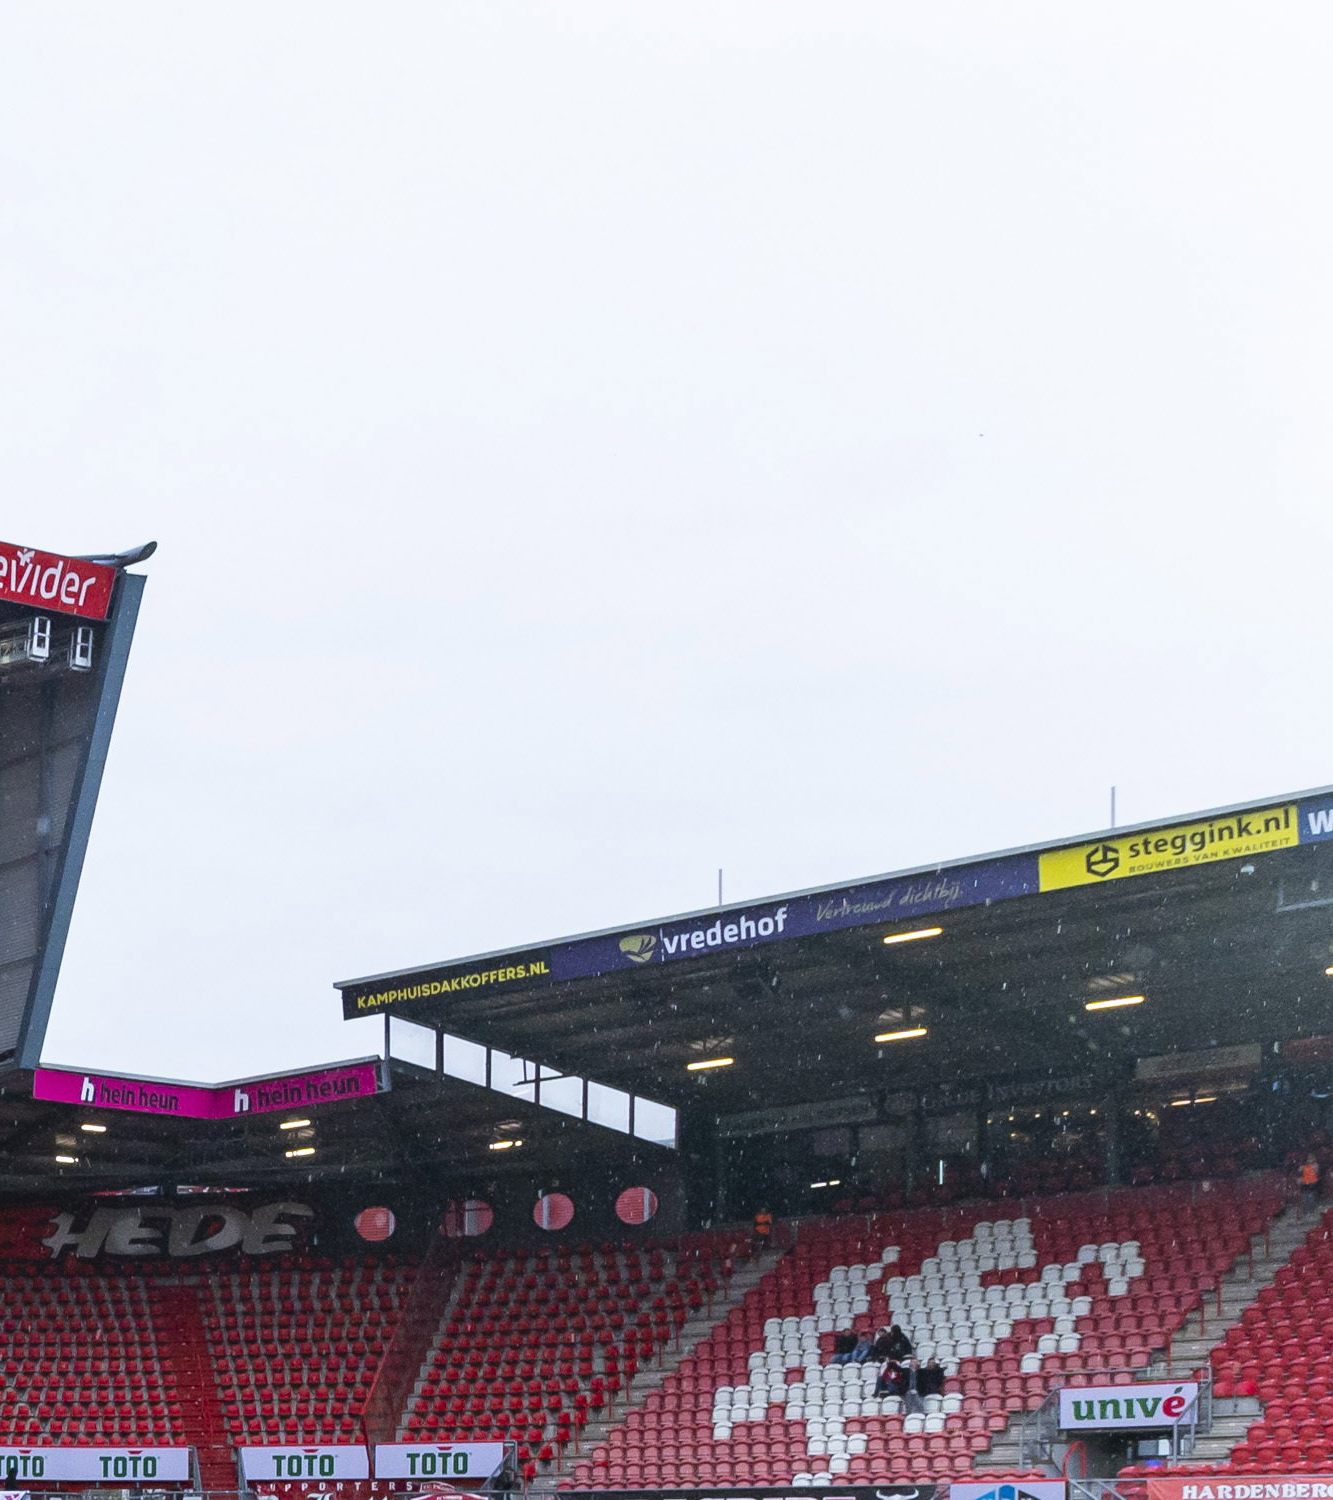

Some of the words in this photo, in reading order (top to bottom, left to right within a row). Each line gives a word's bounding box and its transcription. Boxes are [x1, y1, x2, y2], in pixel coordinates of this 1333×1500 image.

[1129, 809, 1290, 857] steggink.nl
[663, 907, 788, 955] vredehof
[101, 1081, 136, 1105] hein
[139, 1085, 179, 1110] heun
[257, 1081, 302, 1107] hein
[1072, 1386, 1186, 1421] univé
[99, 1454, 157, 1479] TOTO
[273, 1453, 335, 1477] TOTO
[406, 1451, 469, 1476] TOTO
